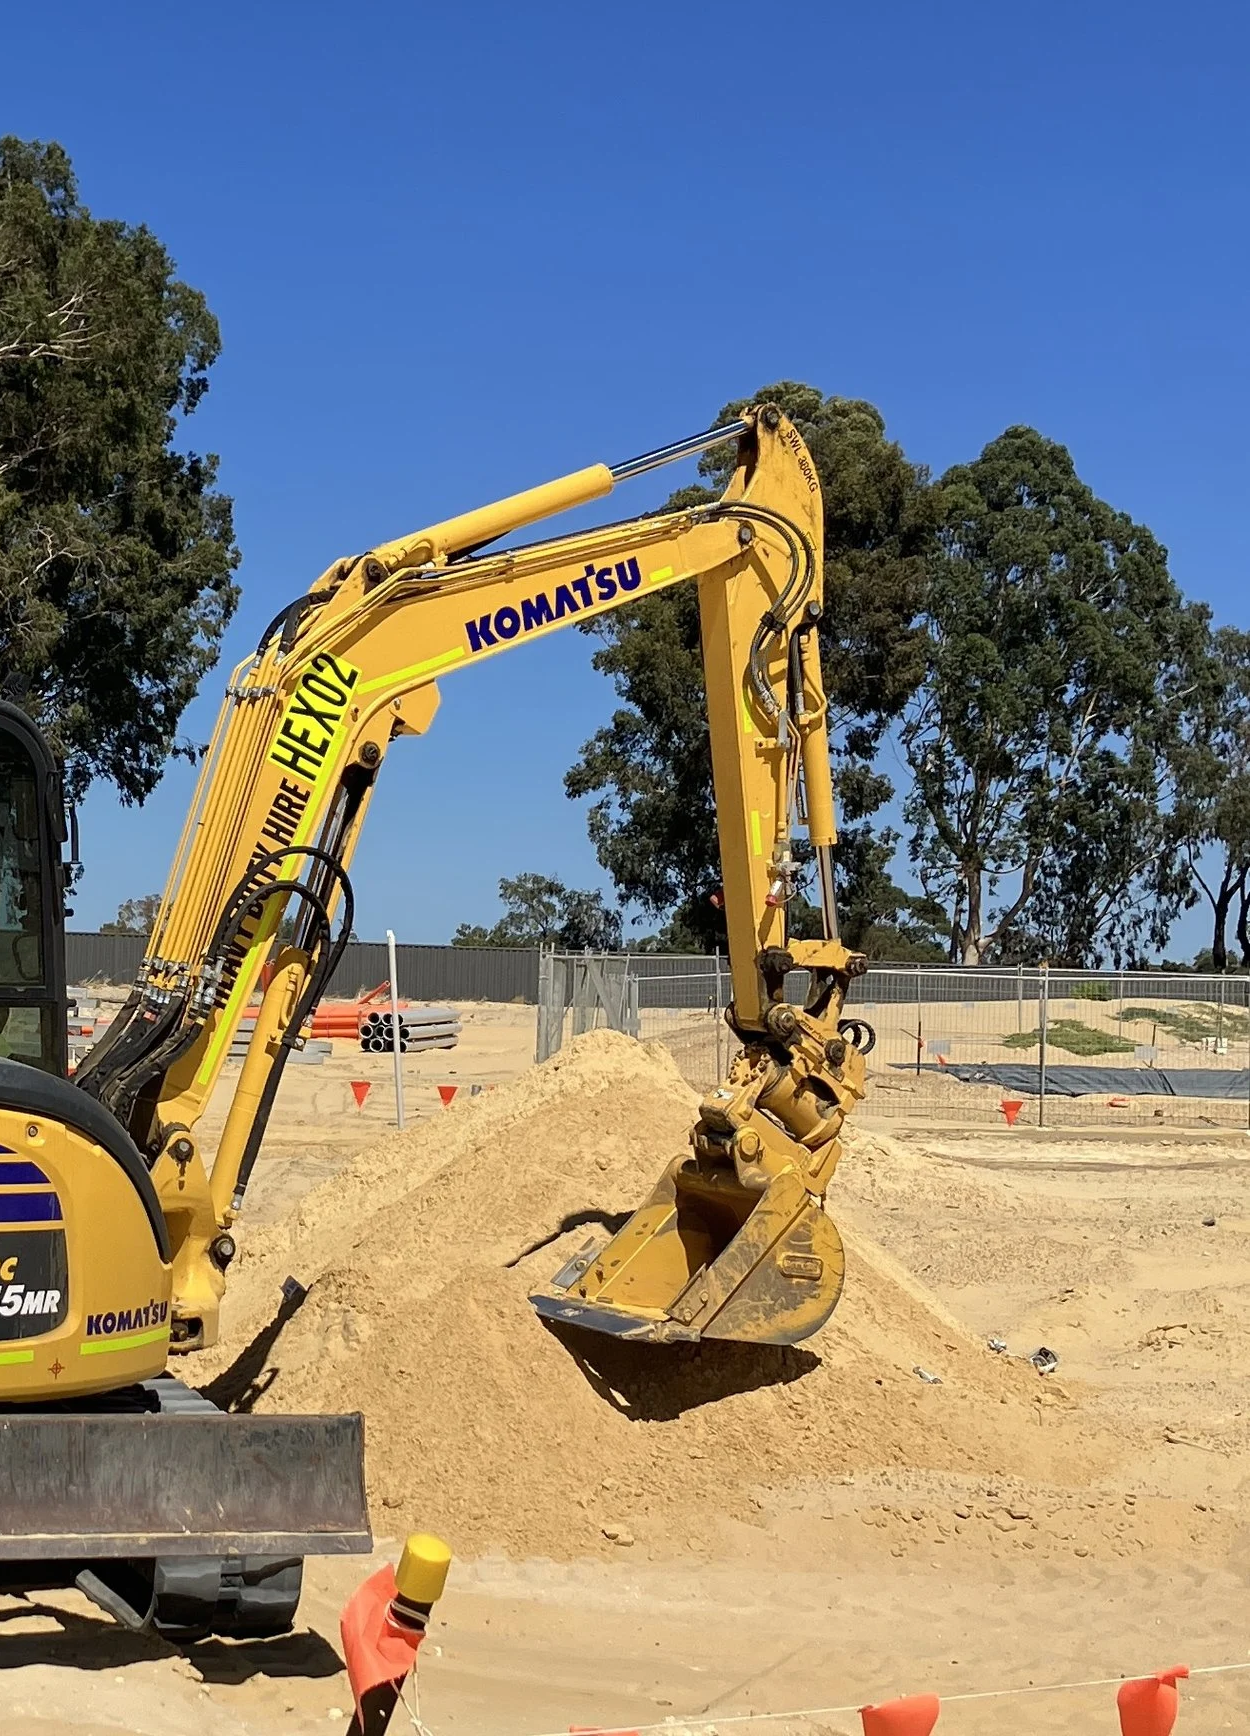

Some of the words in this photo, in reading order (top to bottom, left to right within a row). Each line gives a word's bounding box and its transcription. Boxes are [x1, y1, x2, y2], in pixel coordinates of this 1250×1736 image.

[786, 428, 802, 457] SWL
[464, 556, 642, 652] KOMATSU
[270, 652, 359, 782] HEX02
[260, 777, 311, 847] HIRE
[85, 1299, 169, 1336] KOMATSU
